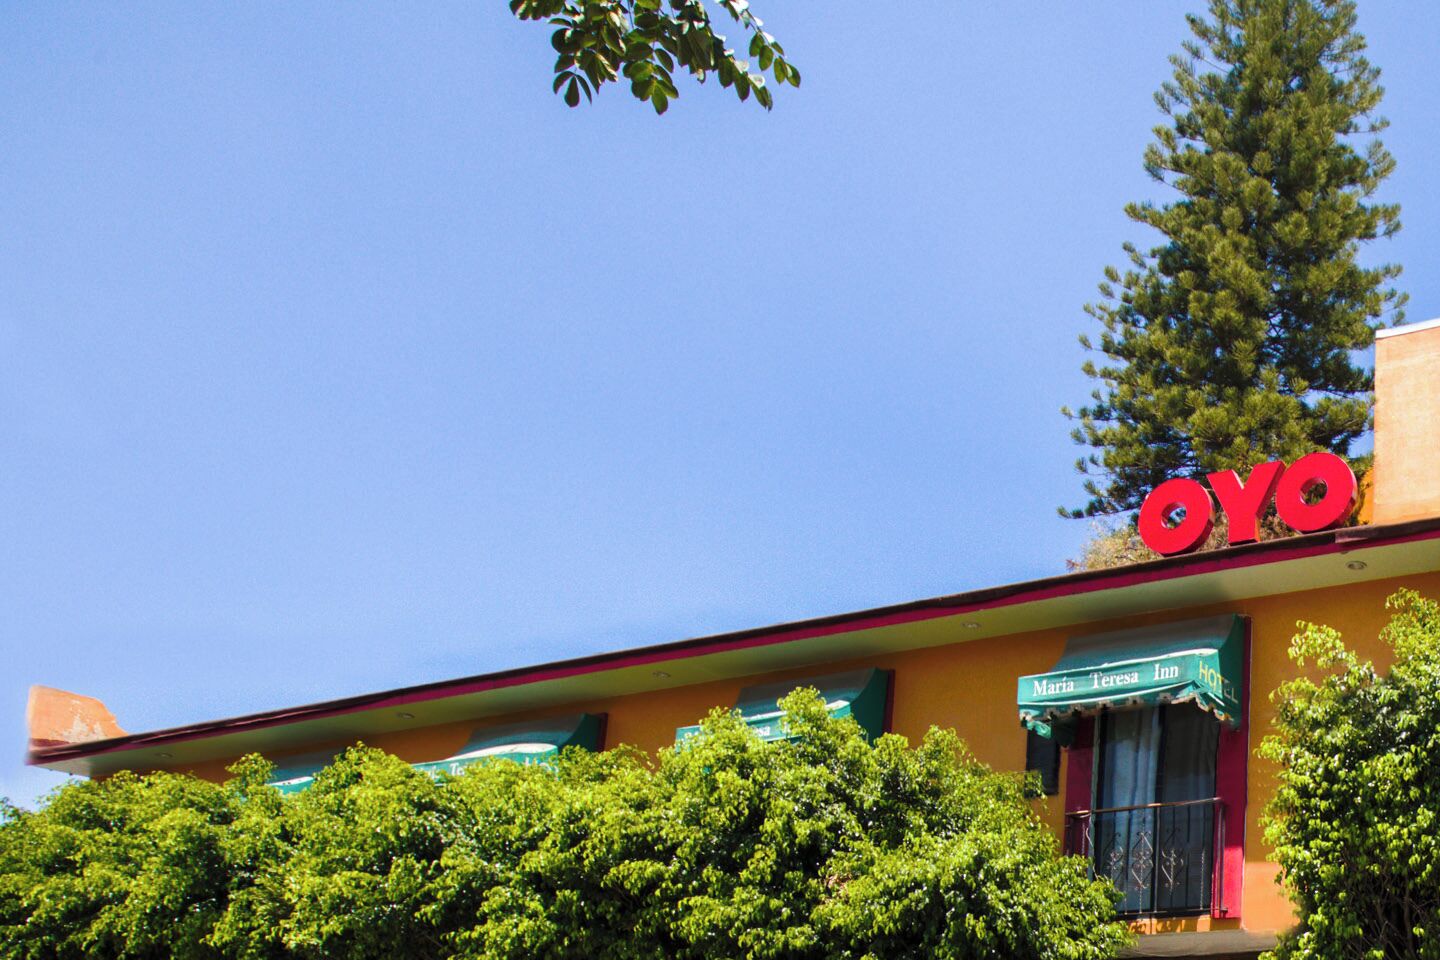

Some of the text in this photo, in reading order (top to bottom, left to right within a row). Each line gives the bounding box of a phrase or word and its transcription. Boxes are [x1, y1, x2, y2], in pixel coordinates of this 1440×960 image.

[1138, 452, 1357, 557] OYO
[1089, 671, 1139, 689] Teresa
[1153, 663, 1179, 680] Inn
